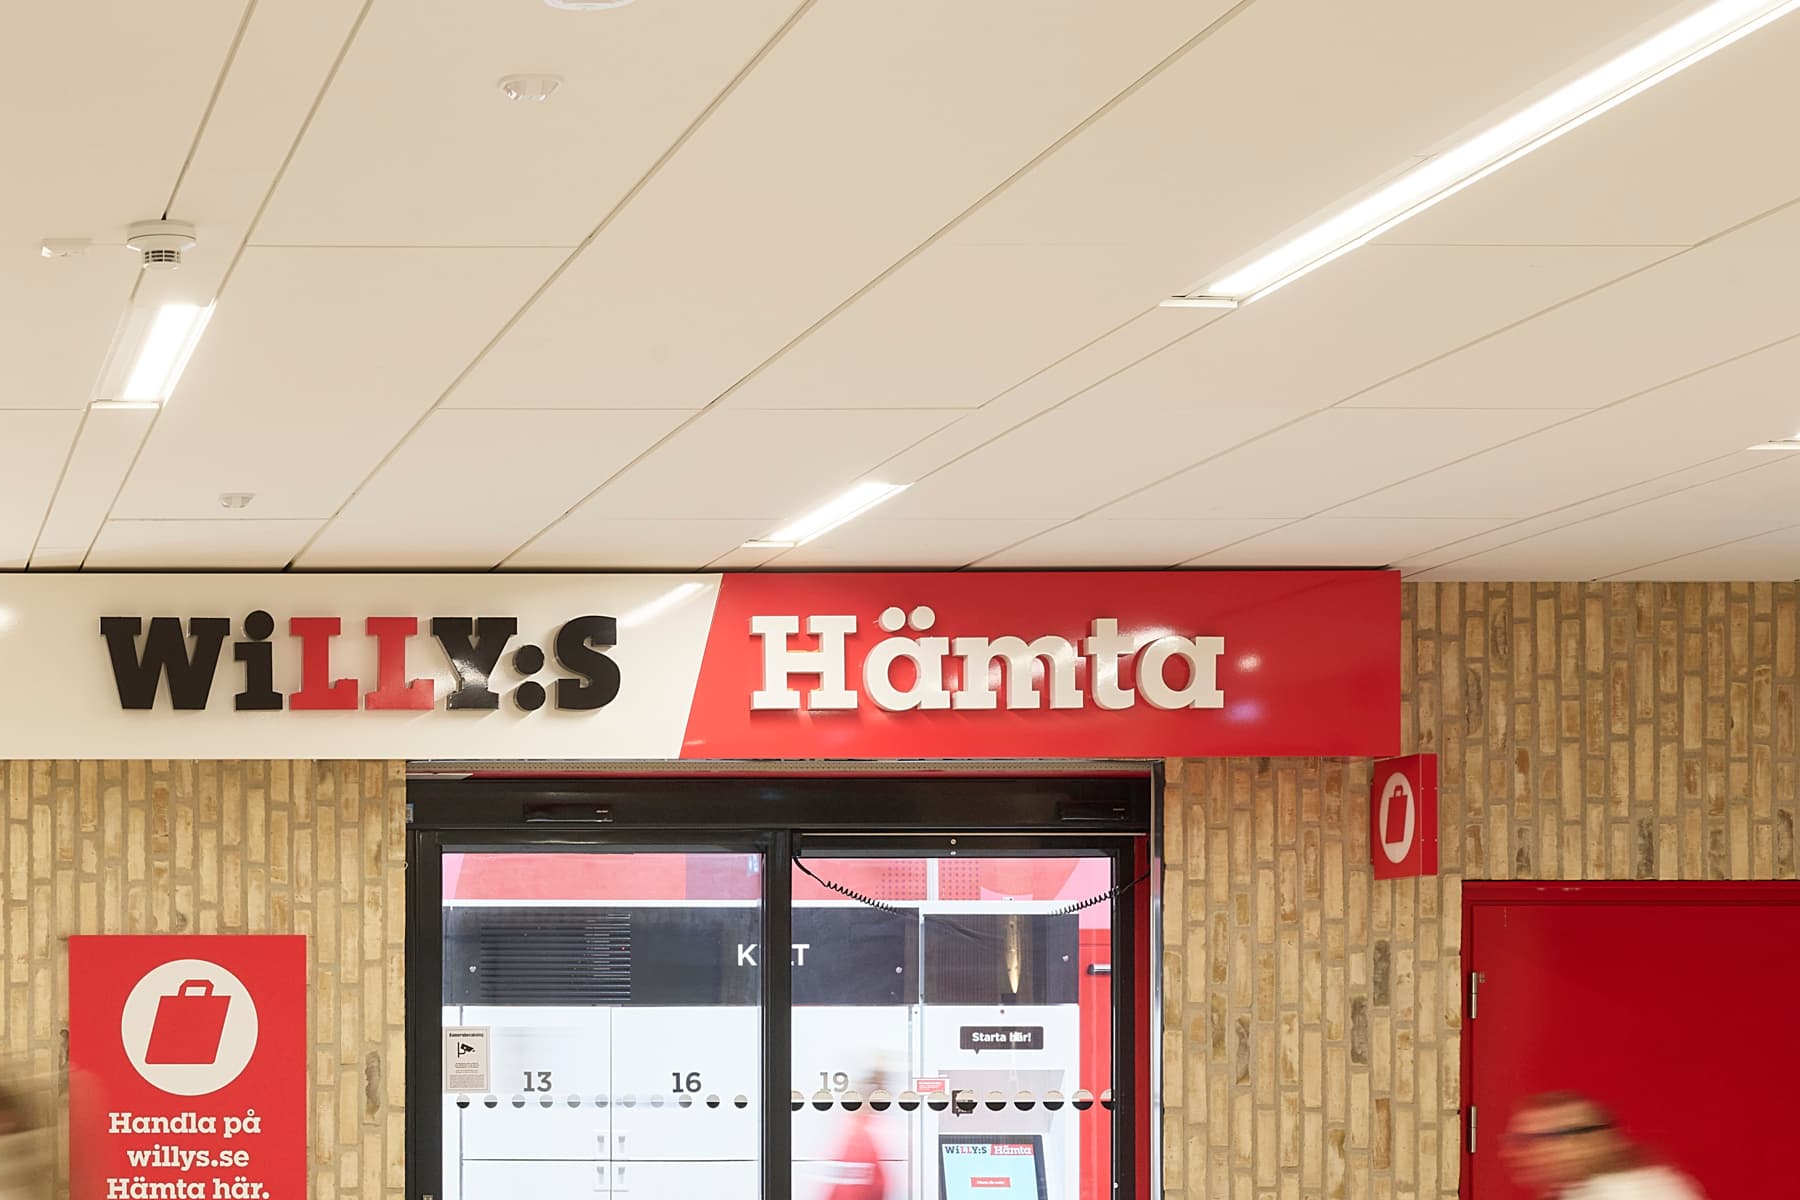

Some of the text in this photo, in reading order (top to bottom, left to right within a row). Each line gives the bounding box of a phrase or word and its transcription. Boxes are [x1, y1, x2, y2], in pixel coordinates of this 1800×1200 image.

[749, 606, 1225, 711] Hämta
[971, 1032, 1007, 1042] Starta
[523, 1071, 552, 1092] 13
[672, 1071, 702, 1093] 16
[819, 1071, 849, 1092] 19
[108, 1109, 261, 1138] Handla på
[127, 1144, 250, 1171] willys.se
[106, 1176, 270, 1200] Hämta här.
